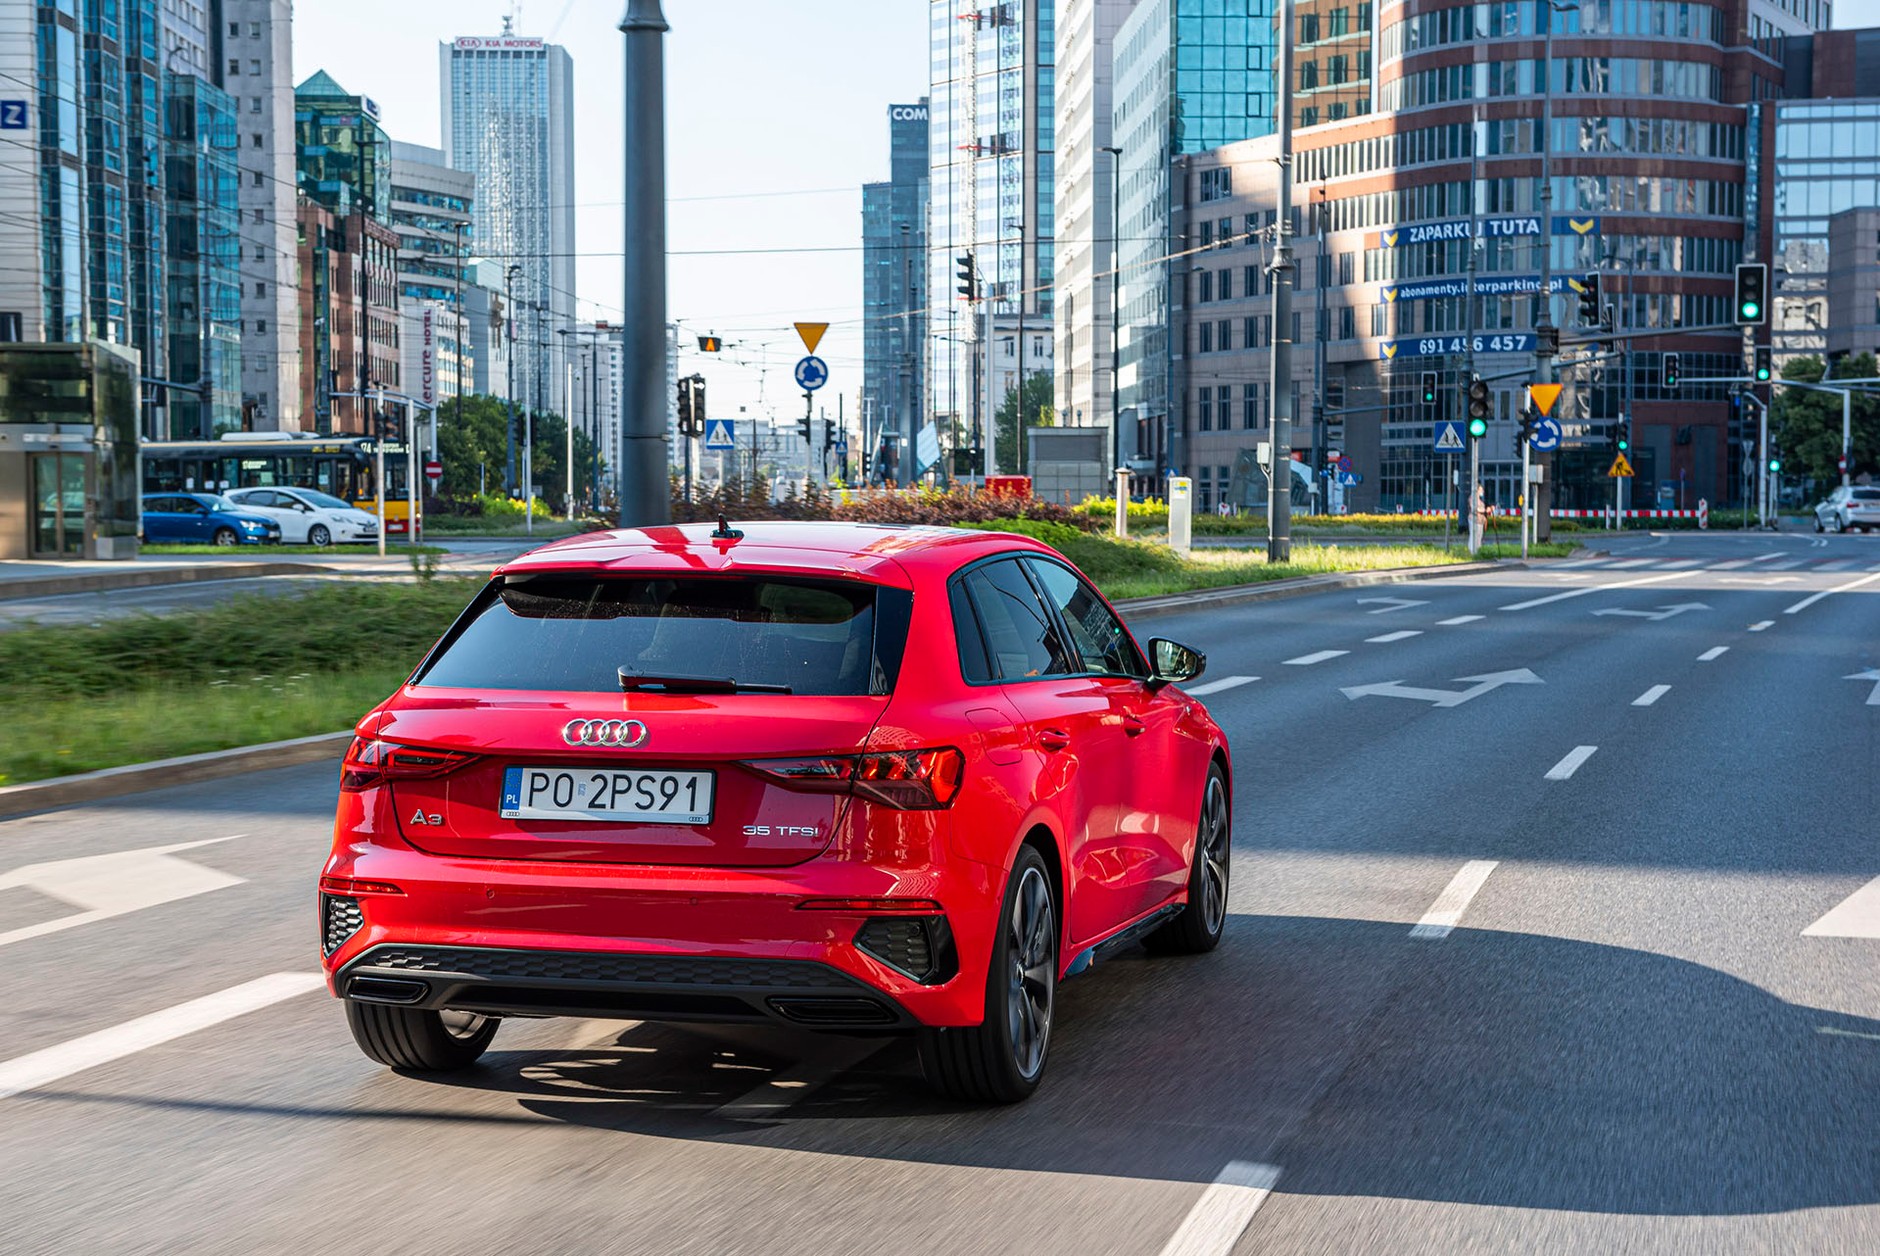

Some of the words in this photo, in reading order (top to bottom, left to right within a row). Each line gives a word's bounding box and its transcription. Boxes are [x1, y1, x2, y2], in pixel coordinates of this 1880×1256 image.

[504, 40, 542, 48] MOTORS
[892, 107, 928, 120] COM
[1490, 218, 1539, 236] TUTA
[1400, 278, 1563, 298] abonamenty.iterparkinpl
[1419, 339, 1445, 354] 691
[1490, 335, 1527, 350] 457
[505, 794, 518, 804] PL
[588, 773, 698, 812] 2PS91
[410, 808, 442, 825] A3
[742, 825, 771, 836] 35
[775, 825, 819, 837] TFSI
